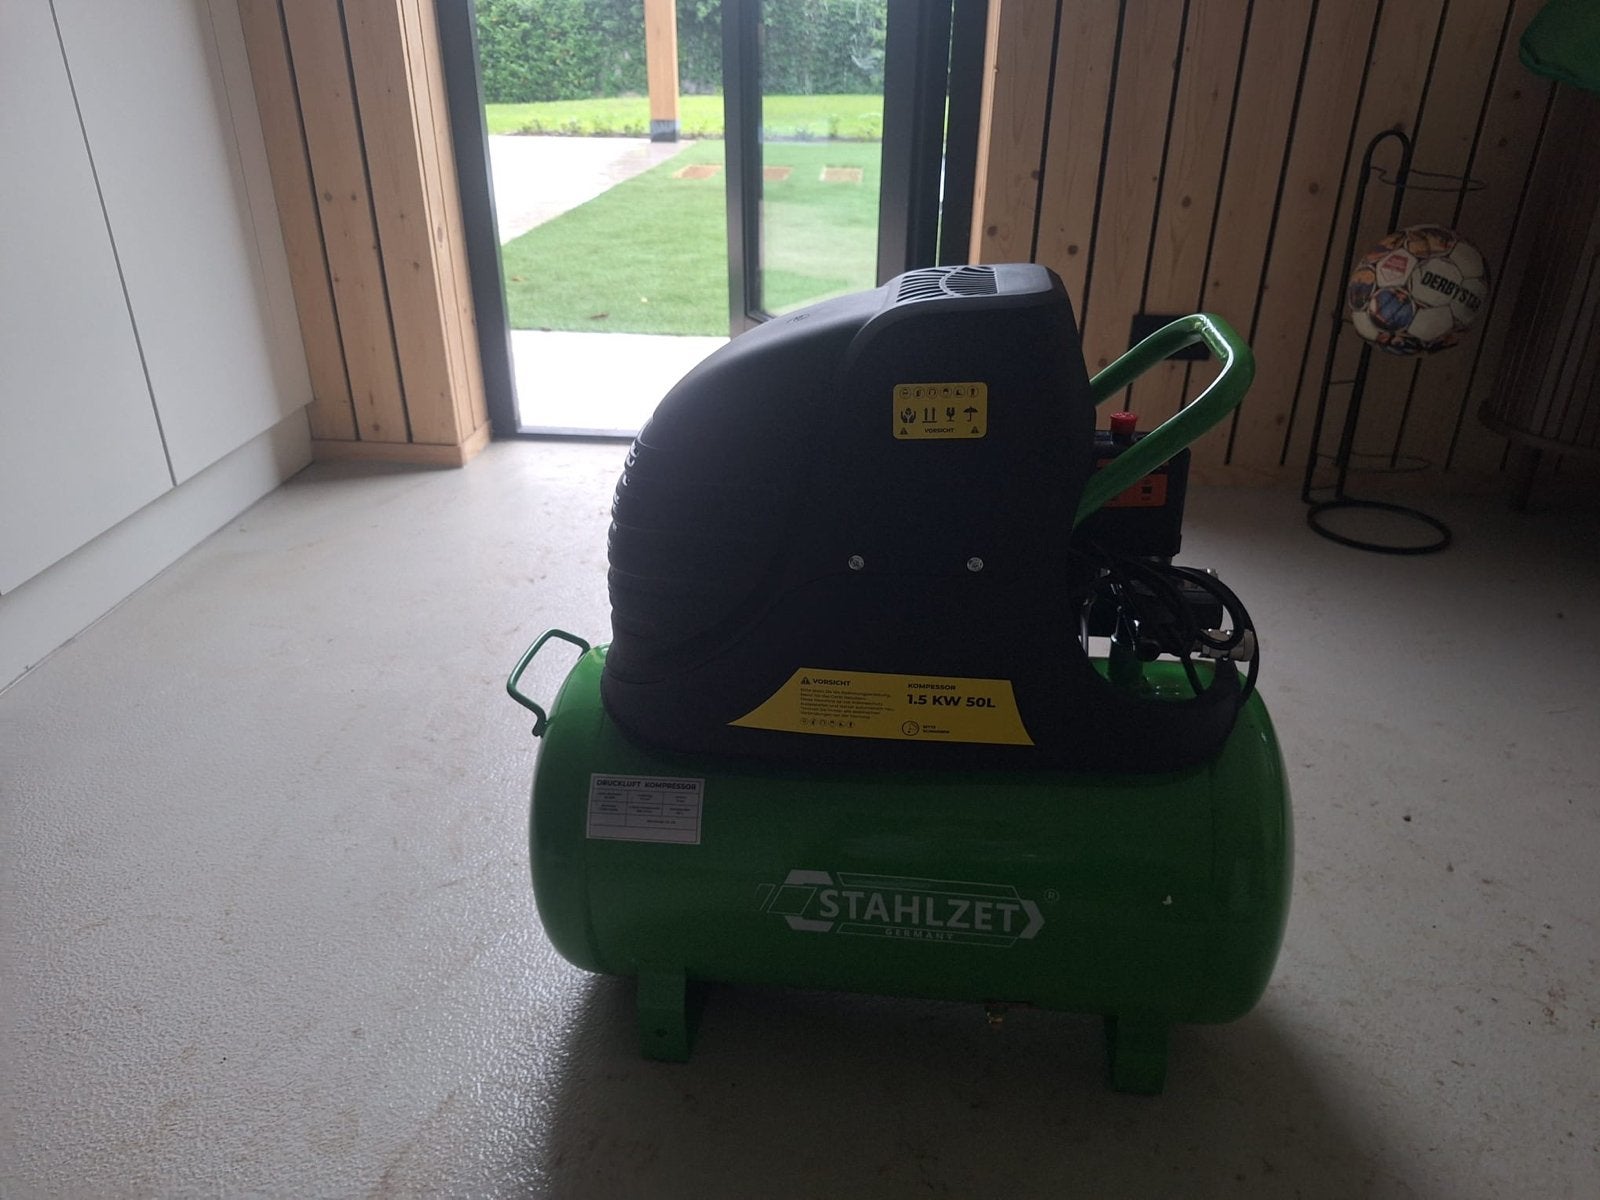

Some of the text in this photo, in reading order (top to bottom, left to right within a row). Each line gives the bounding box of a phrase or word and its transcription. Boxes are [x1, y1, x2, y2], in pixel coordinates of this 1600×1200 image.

[812, 678, 851, 687] VORSICHT
[908, 683, 956, 691] KOMPESSOR
[907, 694, 996, 708] 1.5 KW 50L
[596, 779, 697, 790] DRUCKLUFT KOMPRESSOR
[818, 888, 1022, 933] STAHLZET
[885, 928, 955, 940] GERMANY
